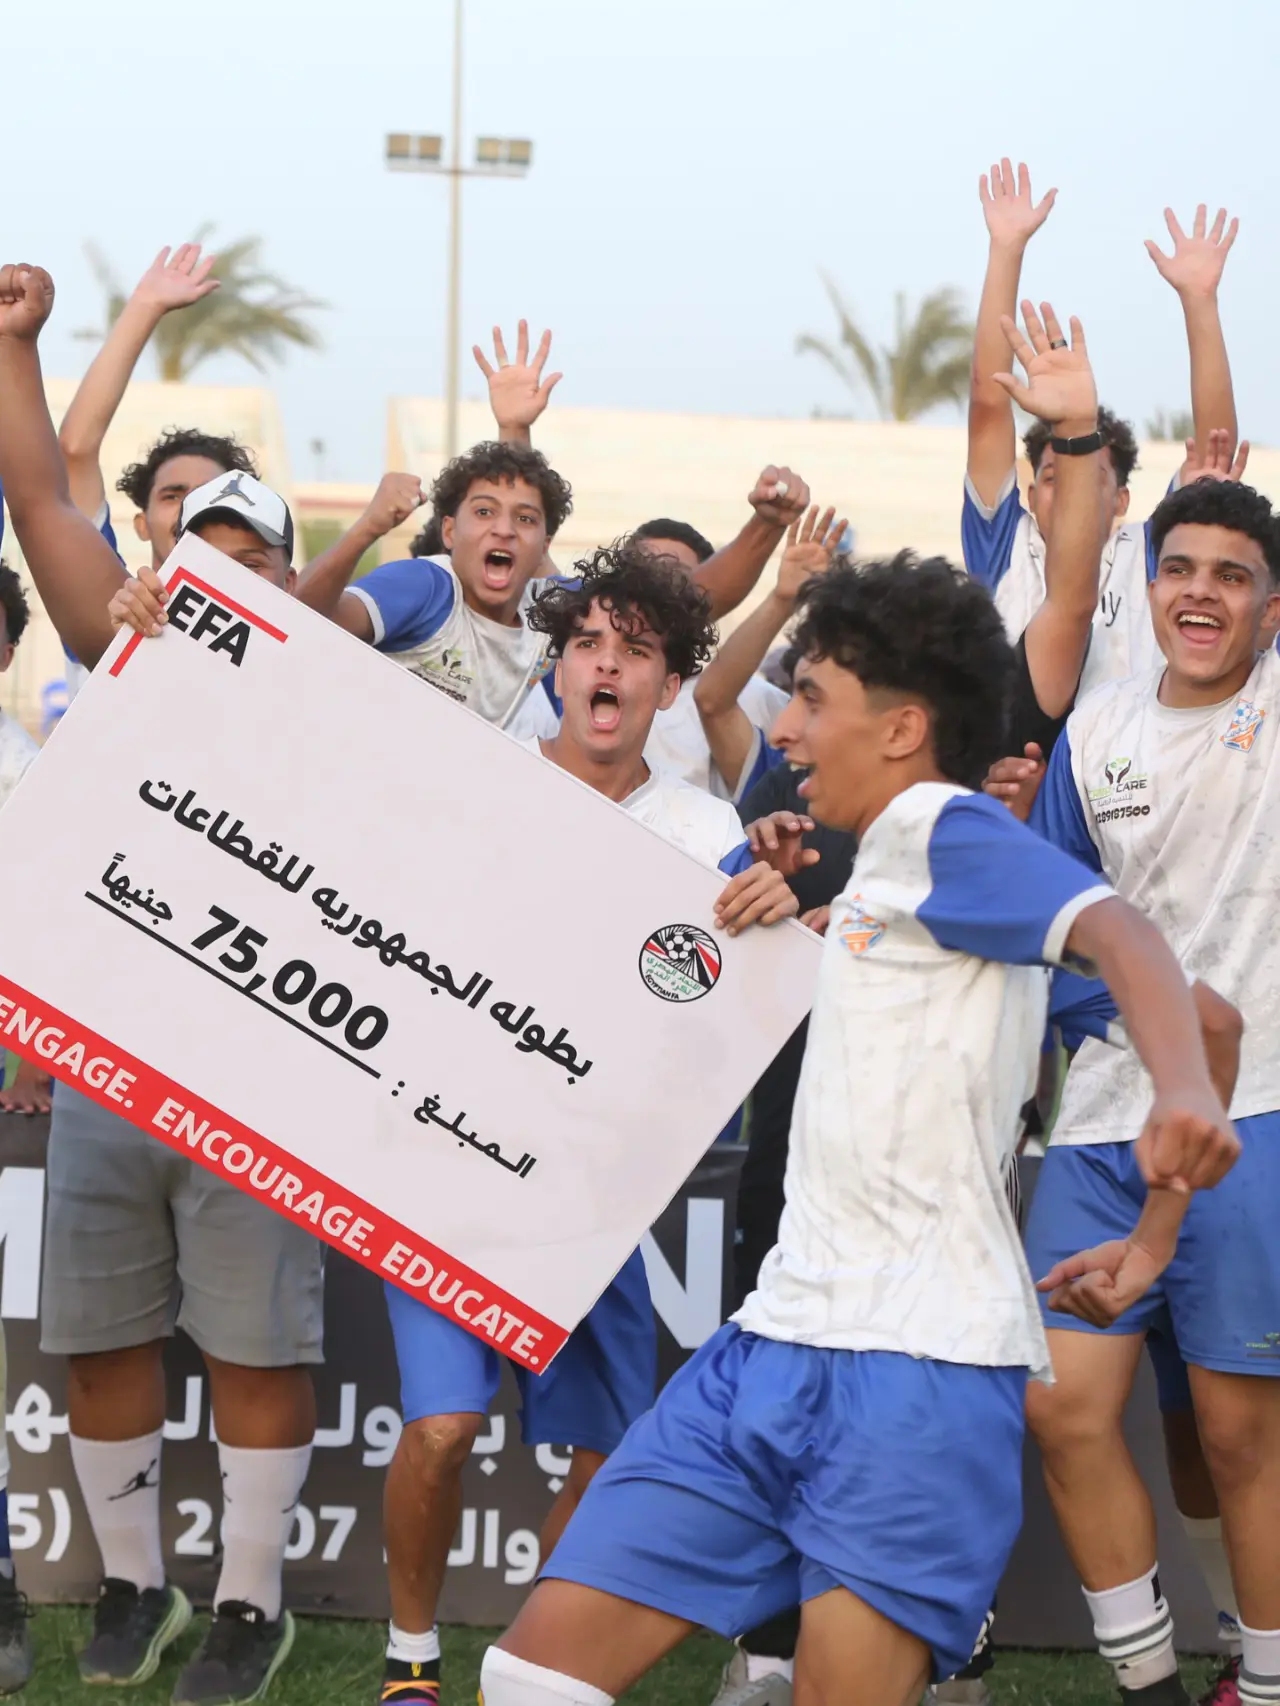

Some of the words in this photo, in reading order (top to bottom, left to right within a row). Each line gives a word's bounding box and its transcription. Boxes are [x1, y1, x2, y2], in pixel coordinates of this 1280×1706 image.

[167, 585, 251, 667] EFA
[1115, 779, 1148, 793] CARE
[138, 779, 316, 894] للقطاعات
[190, 904, 389, 1051] 75,000
[311, 887, 493, 1009] الجمهوريه
[645, 973, 671, 997] EGYPTIAN
[490, 1001, 593, 1085] بطوله
[413, 1094, 537, 1179] المبلغ
[151, 1097, 375, 1257] ENCOURAGE.
[379, 1241, 544, 1365] EDUCATE.
[174, 1500, 358, 1563] 207
